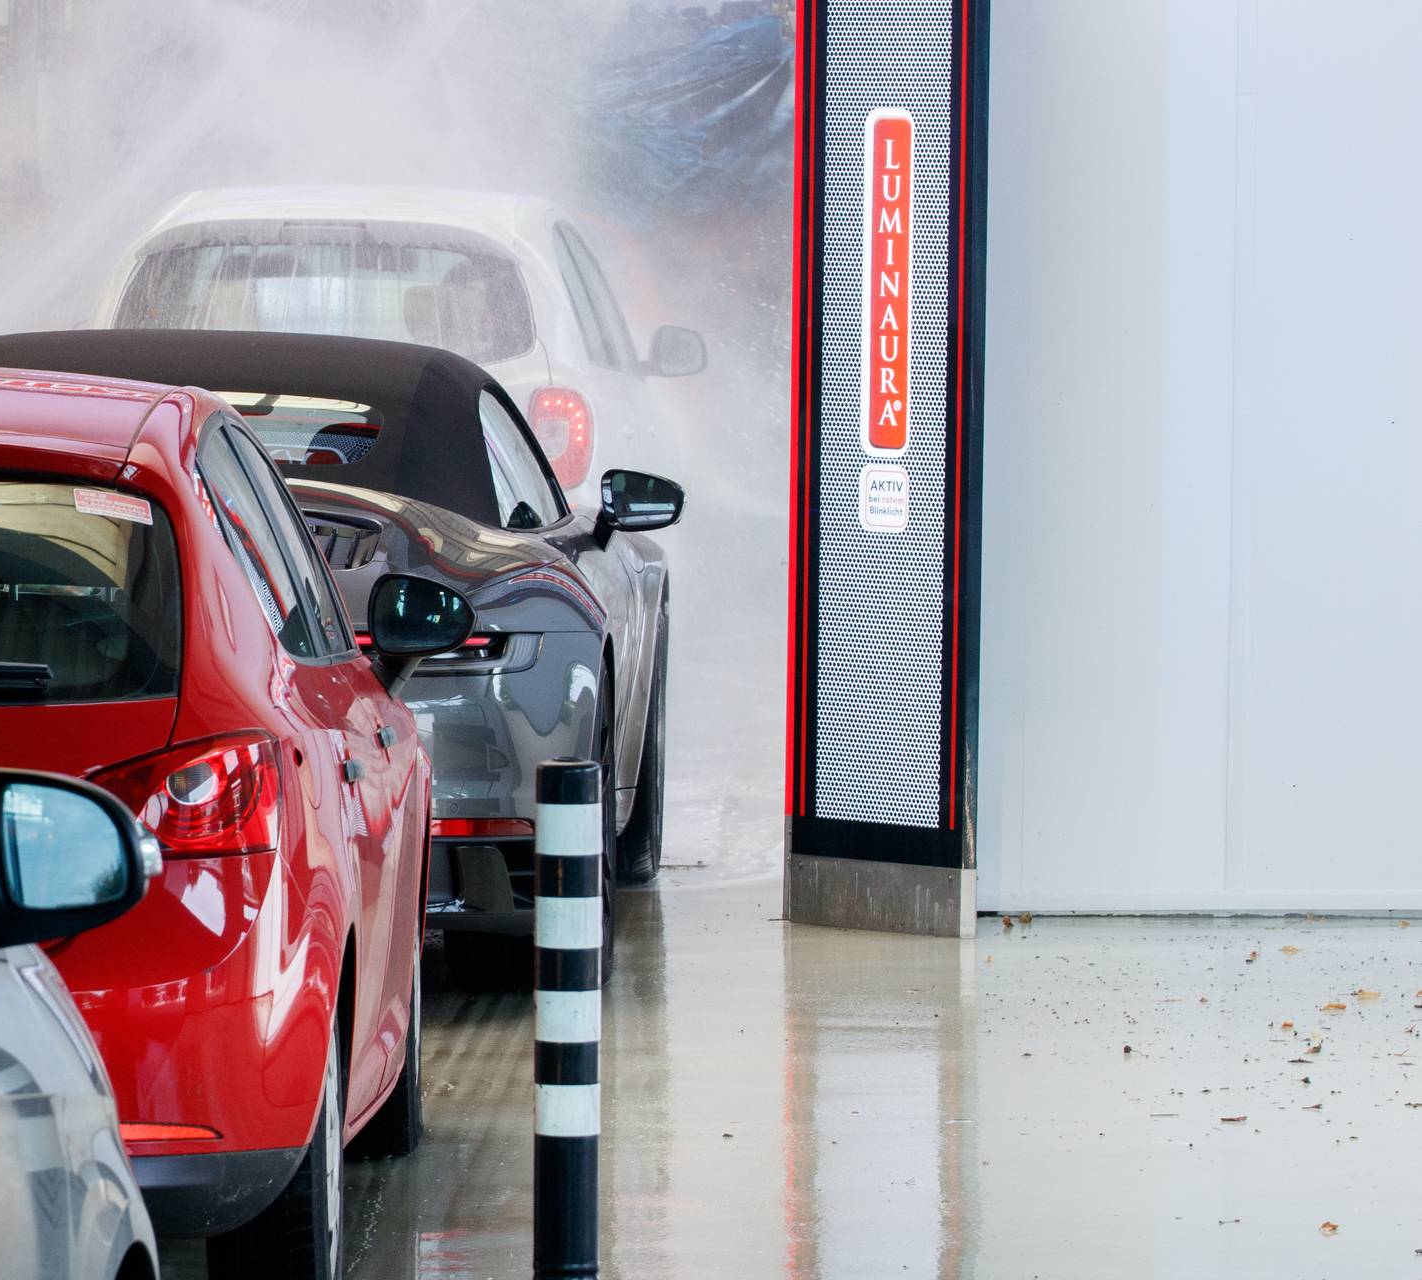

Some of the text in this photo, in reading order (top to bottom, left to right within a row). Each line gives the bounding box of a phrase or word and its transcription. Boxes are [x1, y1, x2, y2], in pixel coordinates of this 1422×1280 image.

[870, 480, 903, 492] AKTIV
[868, 494, 905, 504] bei rotem
[869, 505, 903, 516] Blinklicht
